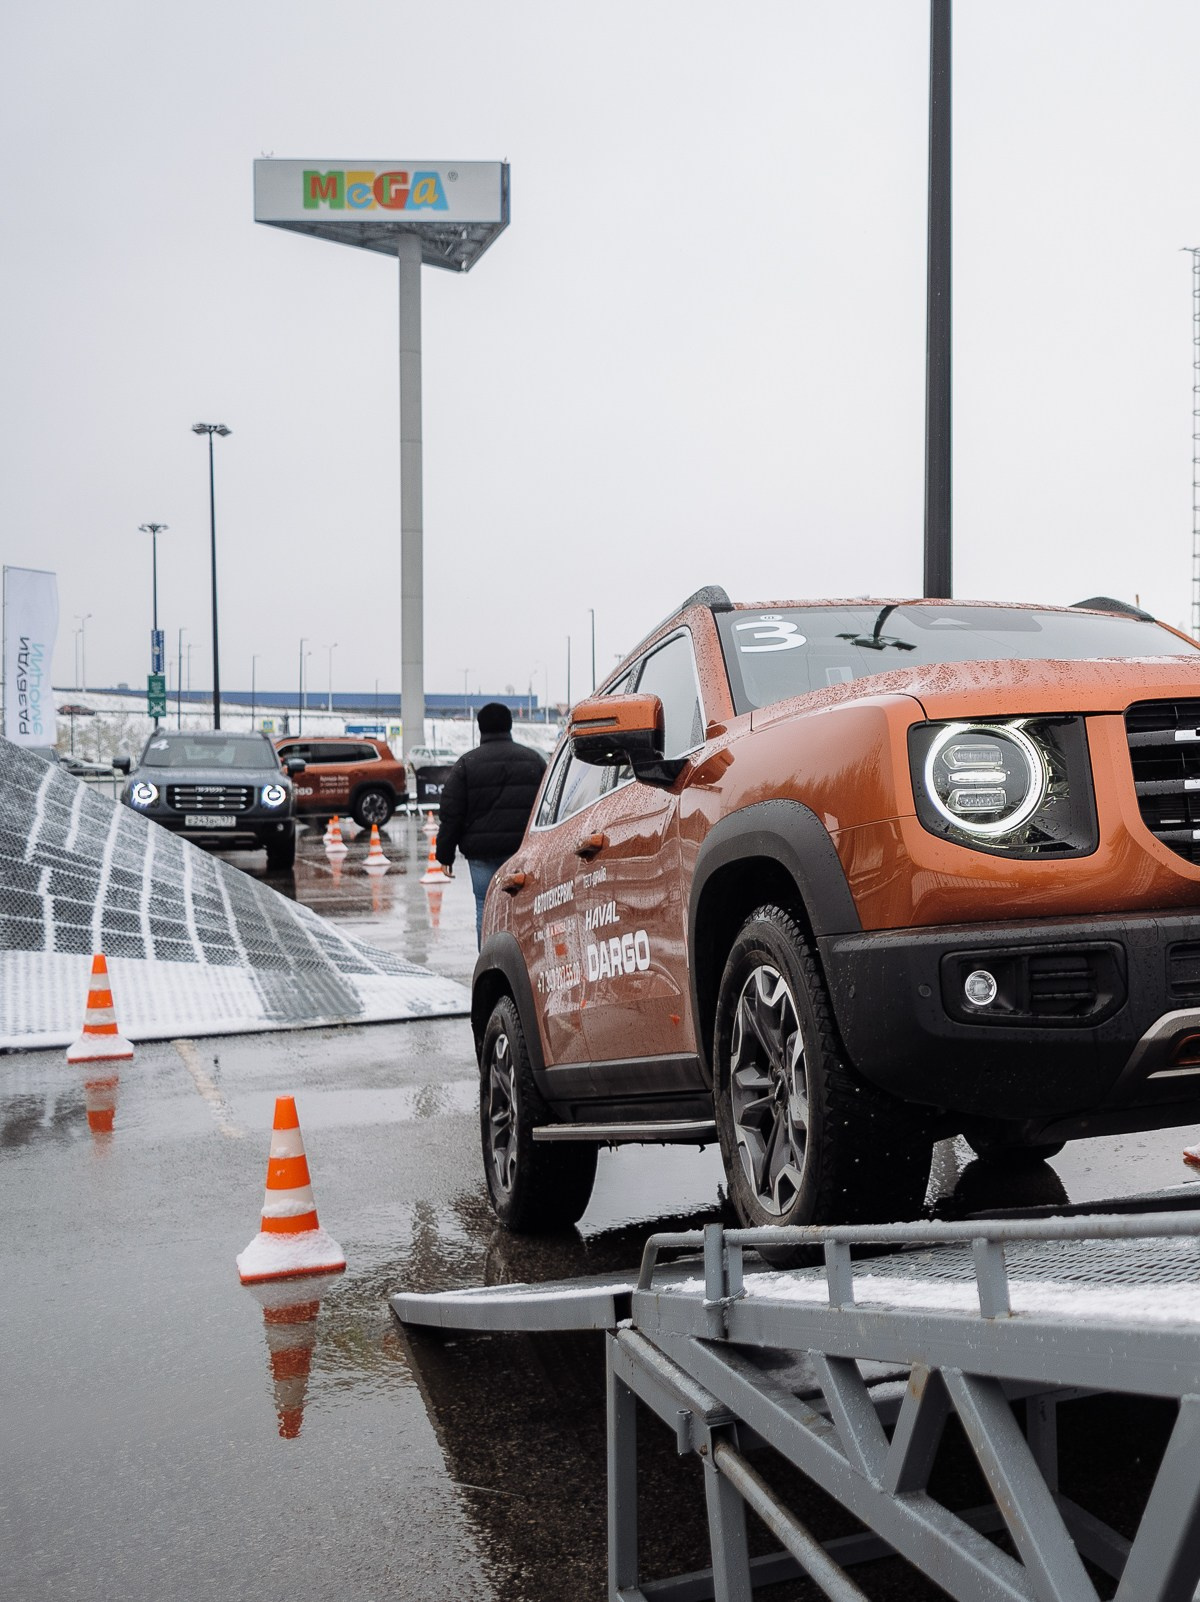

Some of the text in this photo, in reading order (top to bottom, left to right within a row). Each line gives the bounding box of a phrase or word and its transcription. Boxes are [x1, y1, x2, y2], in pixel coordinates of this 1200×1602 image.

[736, 621, 807, 653] 3
[17, 637, 30, 735] РАЗБУДИ
[29, 642, 44, 736] ЭМОЦИИ
[585, 901, 620, 931] HAVAL
[587, 930, 650, 982] DARGO
